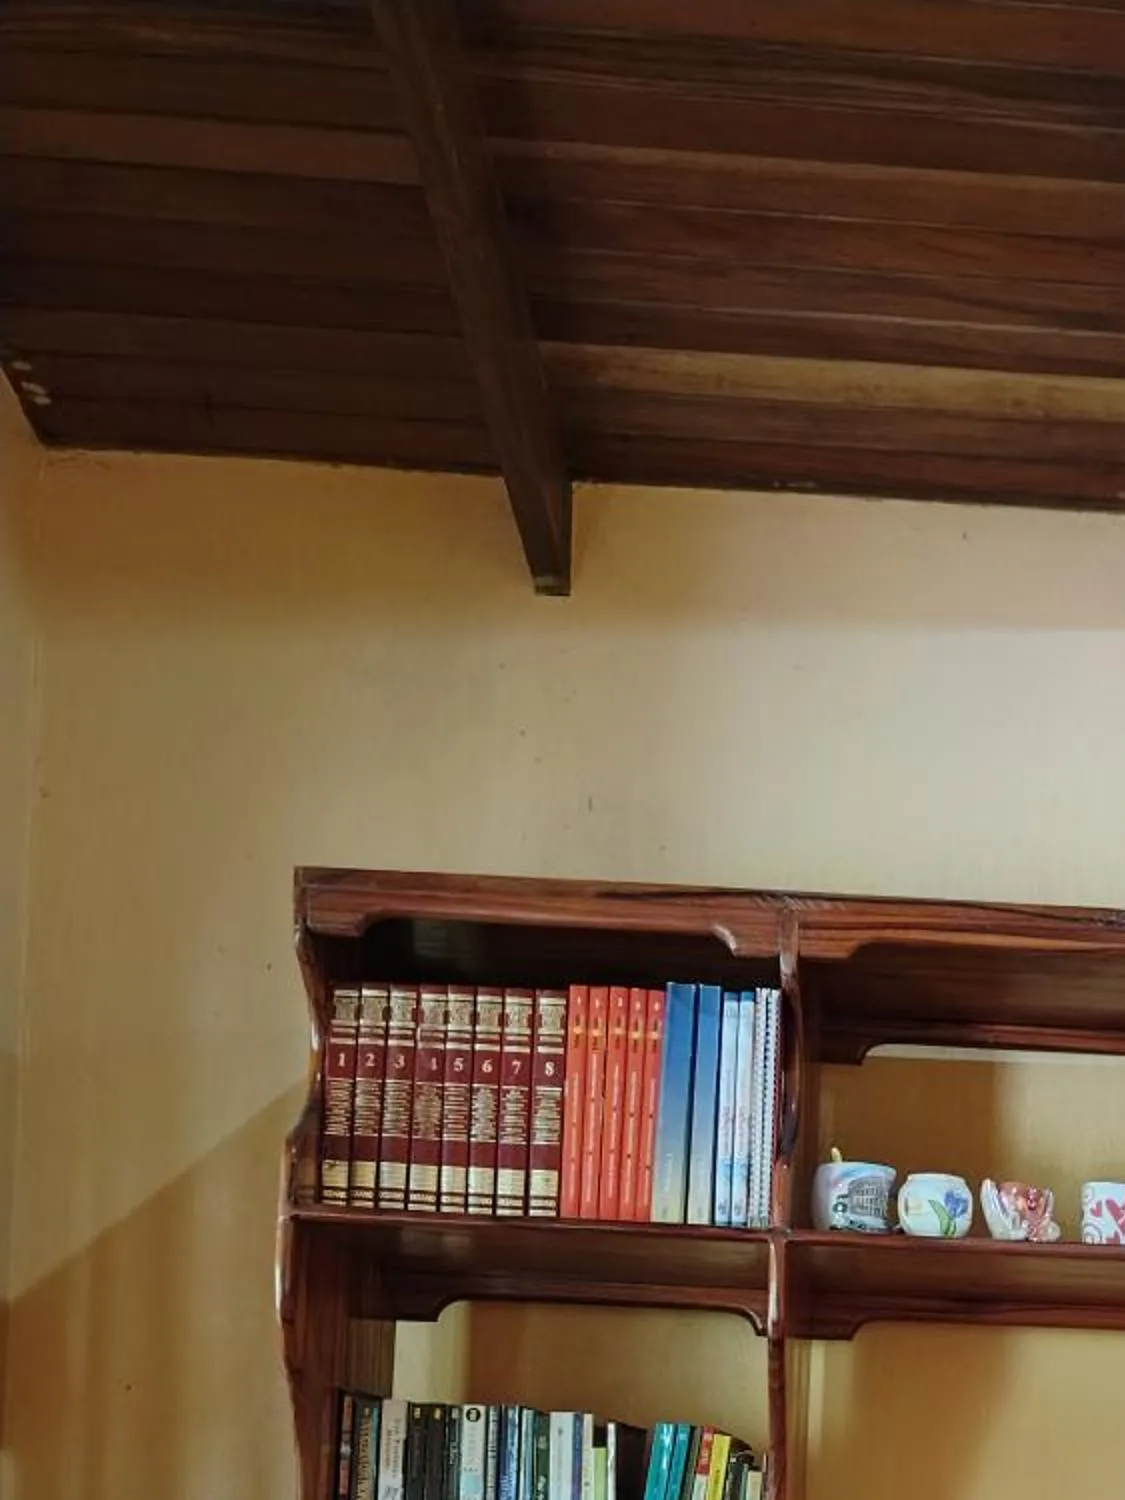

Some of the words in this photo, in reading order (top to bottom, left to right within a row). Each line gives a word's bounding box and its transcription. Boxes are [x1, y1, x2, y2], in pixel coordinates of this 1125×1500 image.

[336, 1052, 346, 1068] 1
[364, 1052, 375, 1068] 2
[394, 1054, 405, 1069] 3
[452, 1057, 464, 1072] 5
[481, 1059, 493, 1074] 6
[511, 1059, 522, 1075] 7
[544, 1061, 555, 1076] 8
